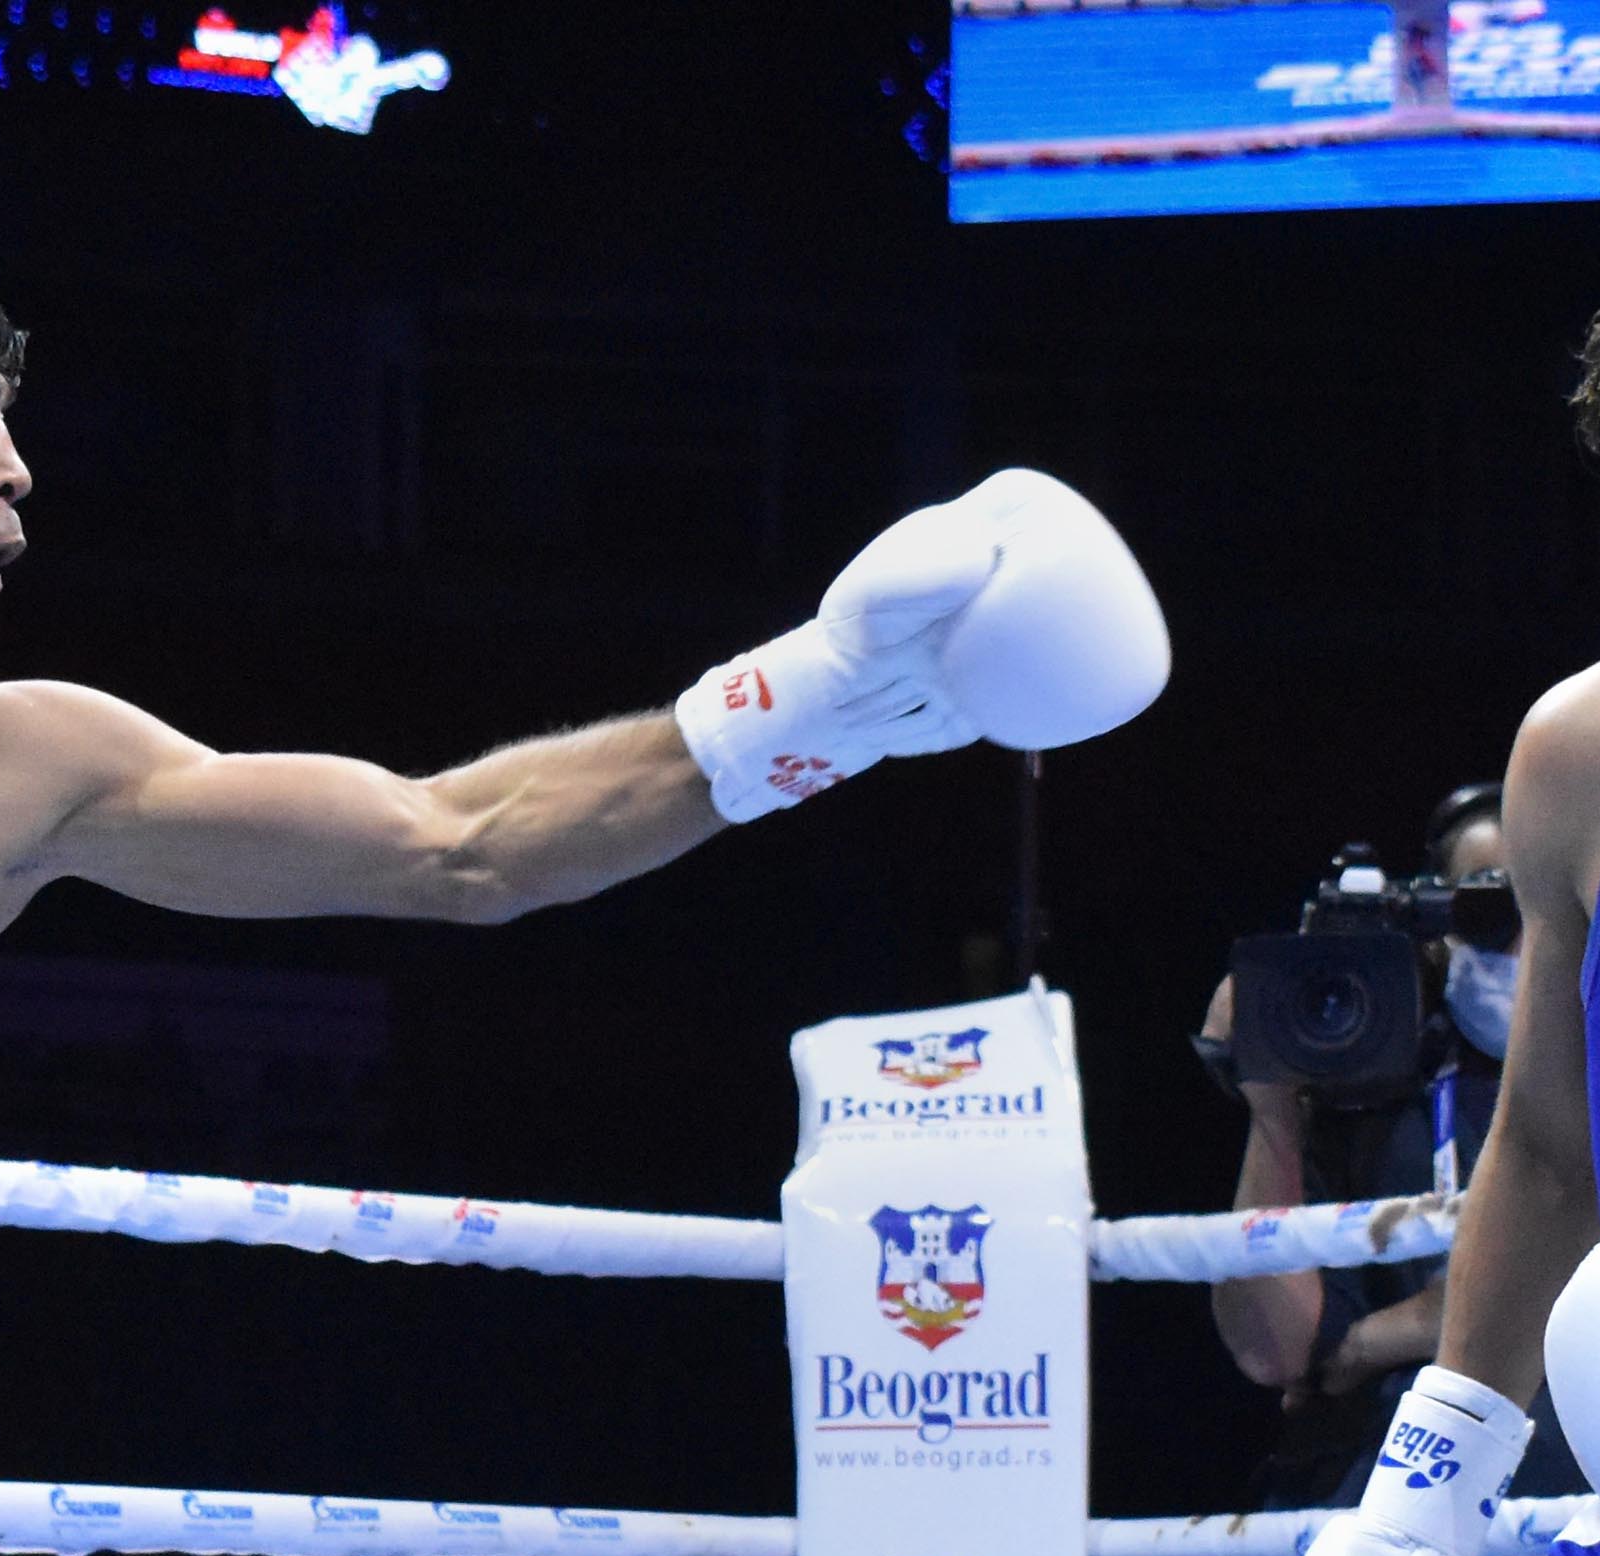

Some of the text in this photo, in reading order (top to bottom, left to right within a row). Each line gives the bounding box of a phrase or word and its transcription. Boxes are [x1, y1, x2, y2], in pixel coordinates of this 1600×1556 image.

[820, 1085, 1046, 1127] Beograd
[817, 1353, 1050, 1443] Beograd
[815, 1446, 1053, 1471] www.beograd.rs
[1392, 1421, 1456, 1463] aiba
